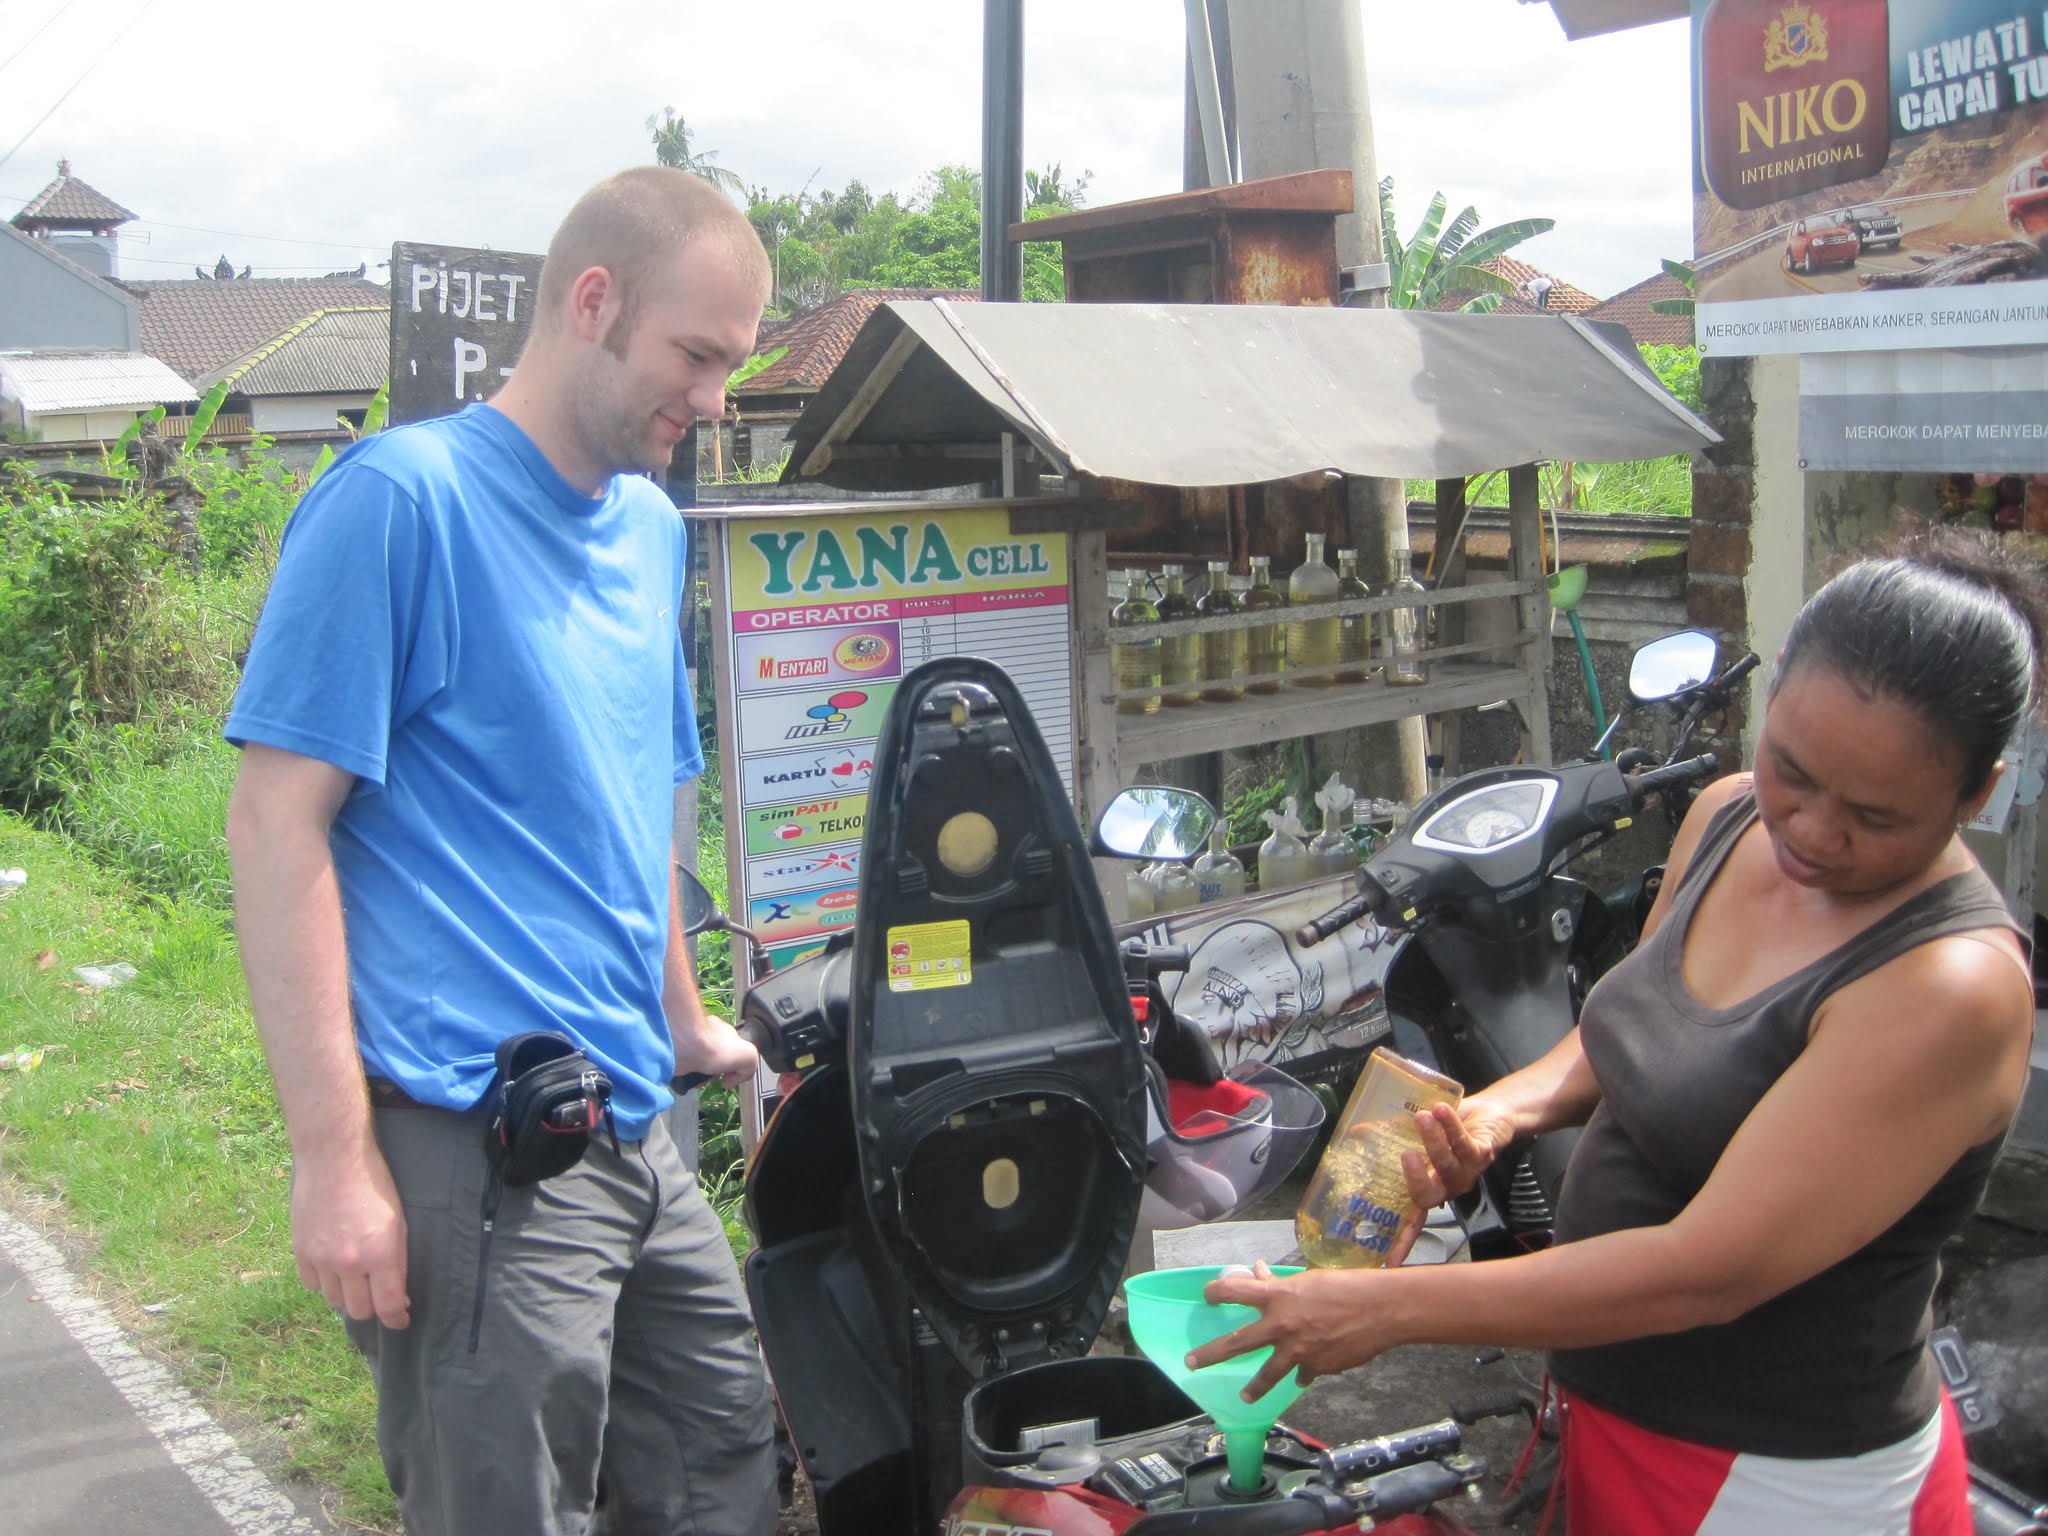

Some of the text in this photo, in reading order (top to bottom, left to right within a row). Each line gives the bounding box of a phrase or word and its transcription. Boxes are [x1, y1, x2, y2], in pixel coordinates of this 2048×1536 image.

[1736, 78, 1867, 154] NIKO
[1741, 144, 1864, 185] INTERNATIONAL
[1706, 321, 1761, 338] MEROKOK
[1763, 320, 1788, 335] DAPAT
[1790, 315, 1869, 333] MENYEBABKAN
[1930, 308, 1999, 326] SERANGAN
[1844, 425, 1918, 439] MEROKOK
[1922, 425, 1972, 438] DAPAT
[750, 523, 1049, 595] YANA CELL
[750, 603, 889, 628] OPERATOR
[921, 637, 931, 645] 20
[759, 658, 827, 679] MENTARI
[763, 767, 827, 785] KARTU
[759, 801, 839, 822] simPATI
[823, 894, 859, 905] beb
